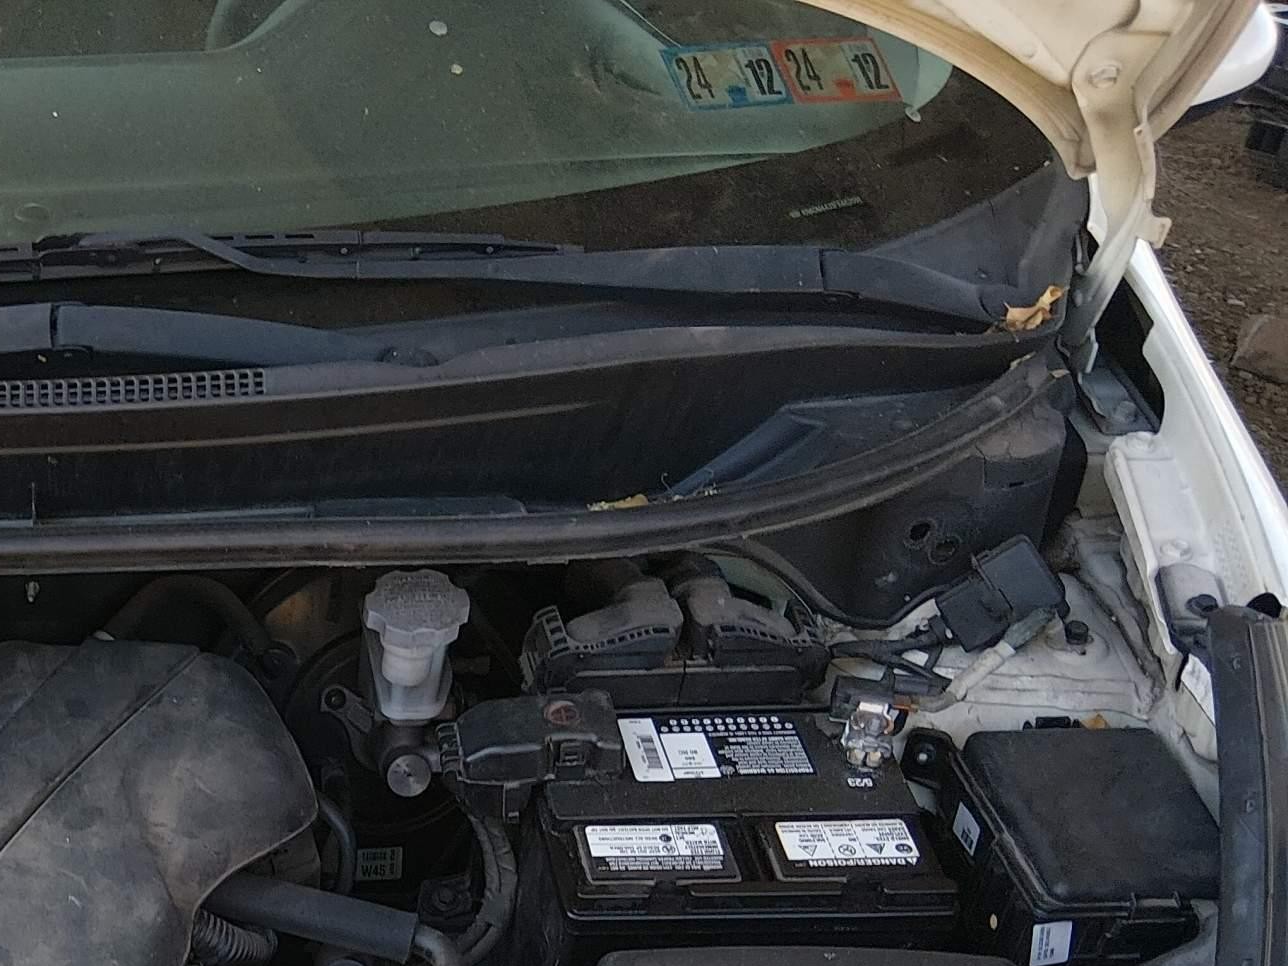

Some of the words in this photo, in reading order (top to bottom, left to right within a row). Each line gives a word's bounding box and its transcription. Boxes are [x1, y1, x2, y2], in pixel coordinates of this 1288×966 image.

[674, 55, 714, 99] 24
[744, 57, 783, 96] 12
[785, 48, 824, 91] 24
[851, 52, 890, 90] 12
